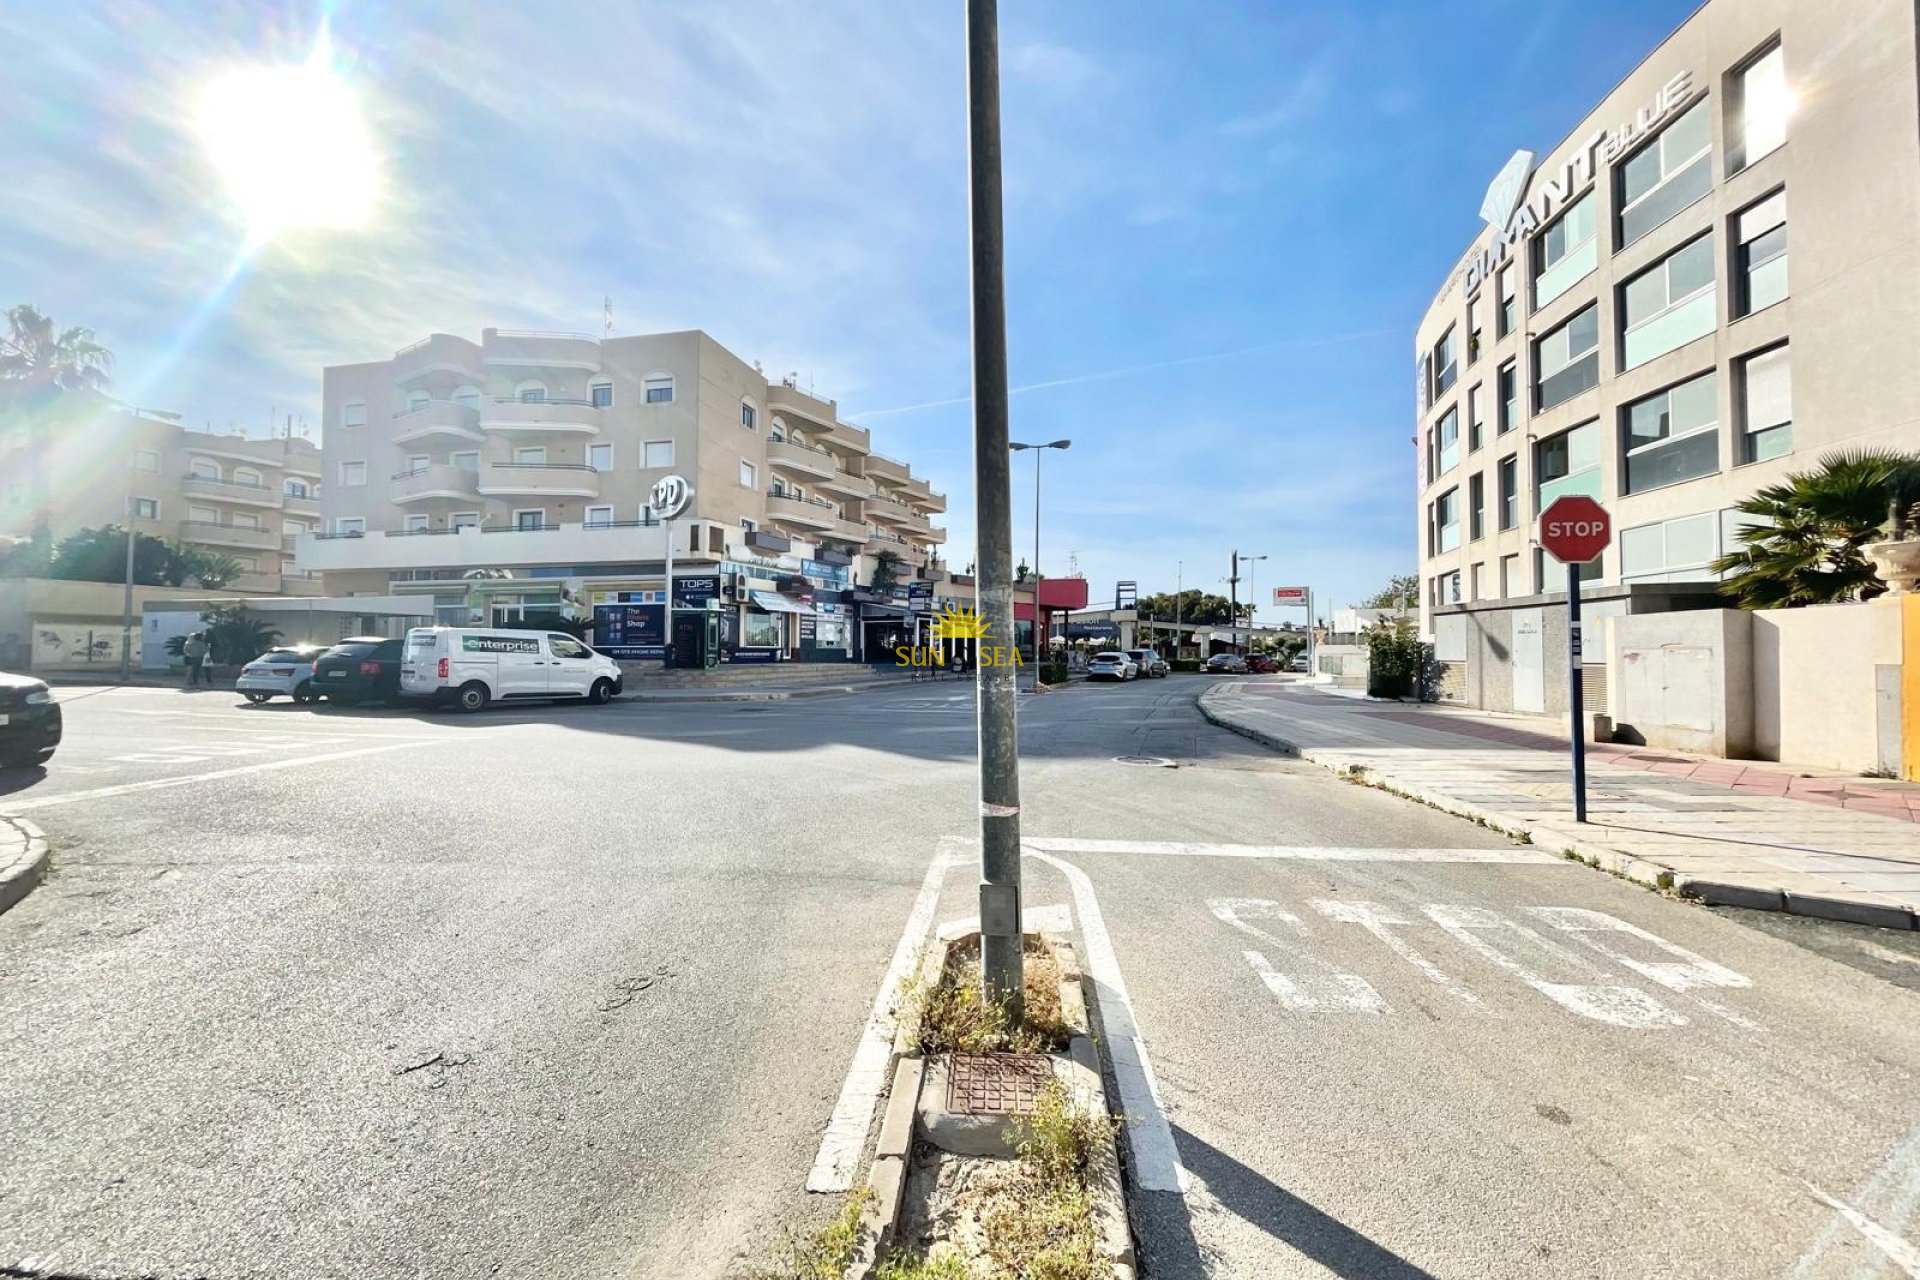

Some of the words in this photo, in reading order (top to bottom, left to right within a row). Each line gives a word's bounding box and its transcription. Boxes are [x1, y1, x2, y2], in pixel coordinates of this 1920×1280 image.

[1599, 69, 1693, 165] BLUE
[1548, 521, 1604, 538] STOP
[679, 579, 714, 588] TOPS
[626, 620, 645, 628] Shop
[466, 639, 538, 651] enterprise
